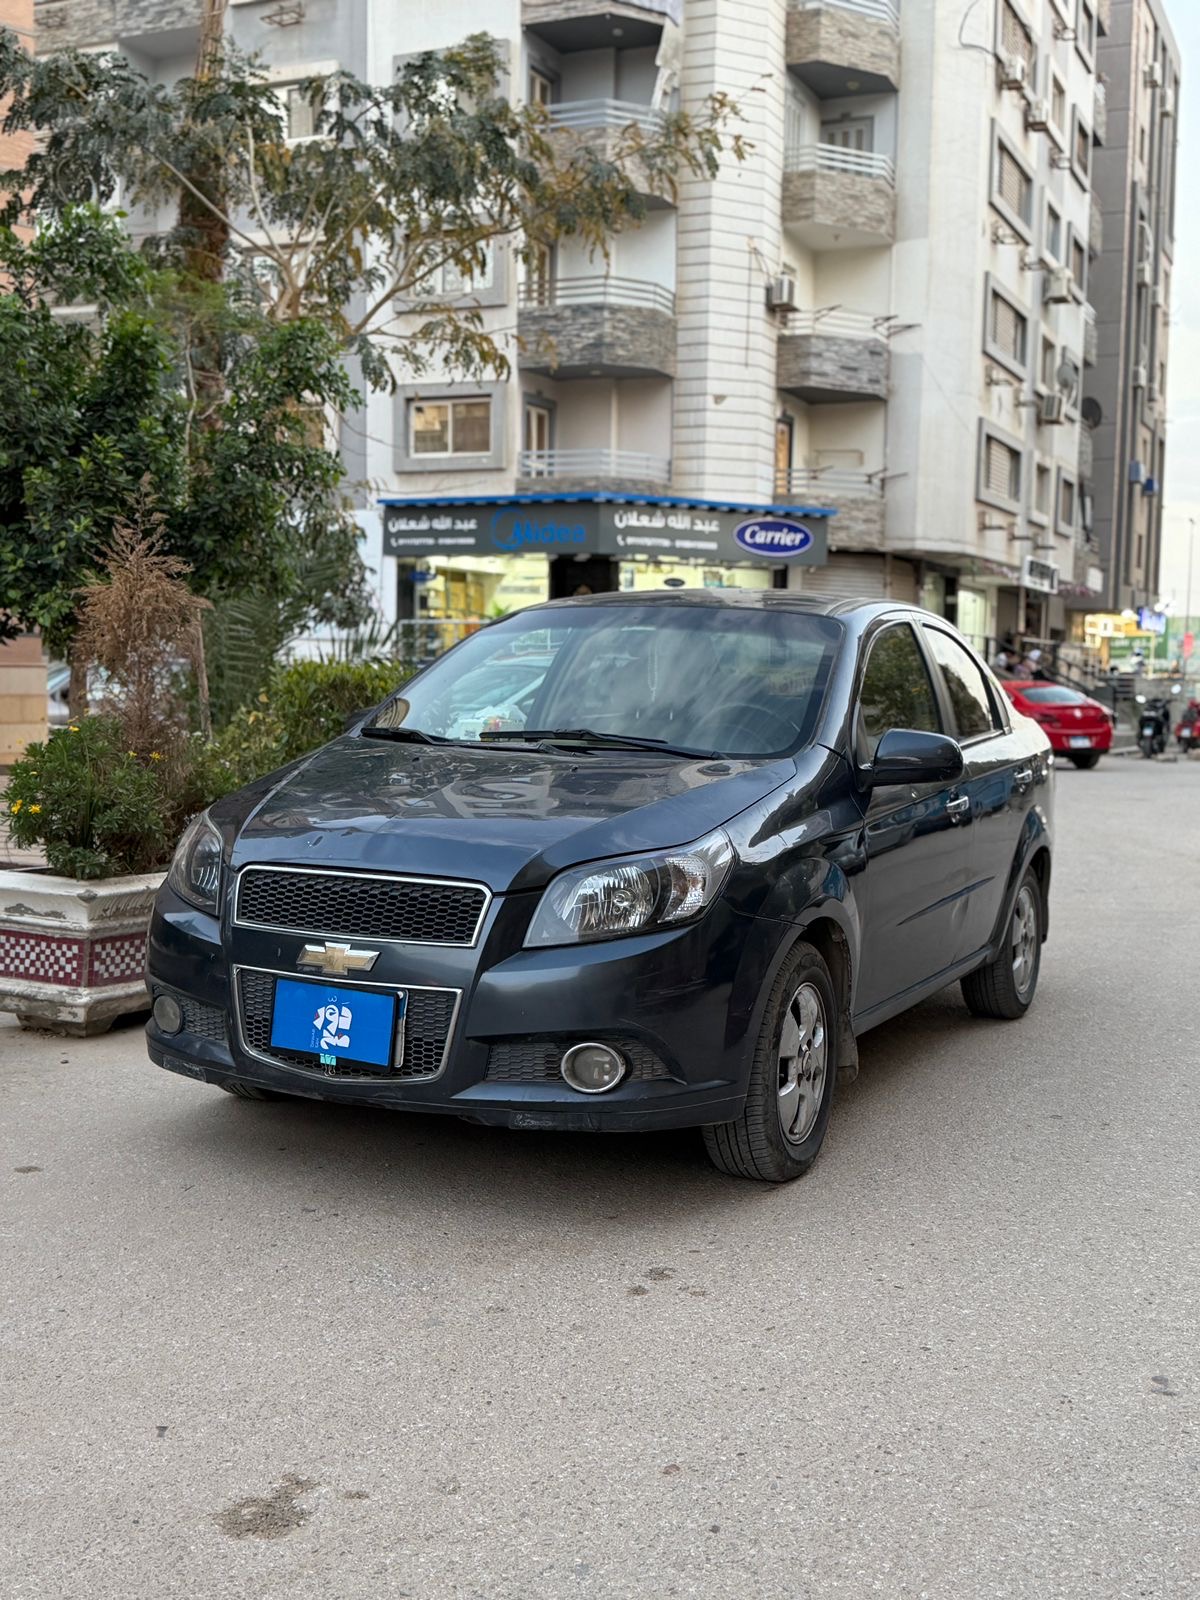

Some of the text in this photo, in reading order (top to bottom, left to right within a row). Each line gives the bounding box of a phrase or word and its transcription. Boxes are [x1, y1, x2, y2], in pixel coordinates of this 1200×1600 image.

[431, 515, 453, 531] الله
[454, 518, 478, 532] عبد
[614, 510, 720, 534] عبد الله شعلان
[744, 525, 805, 546] Carrier
